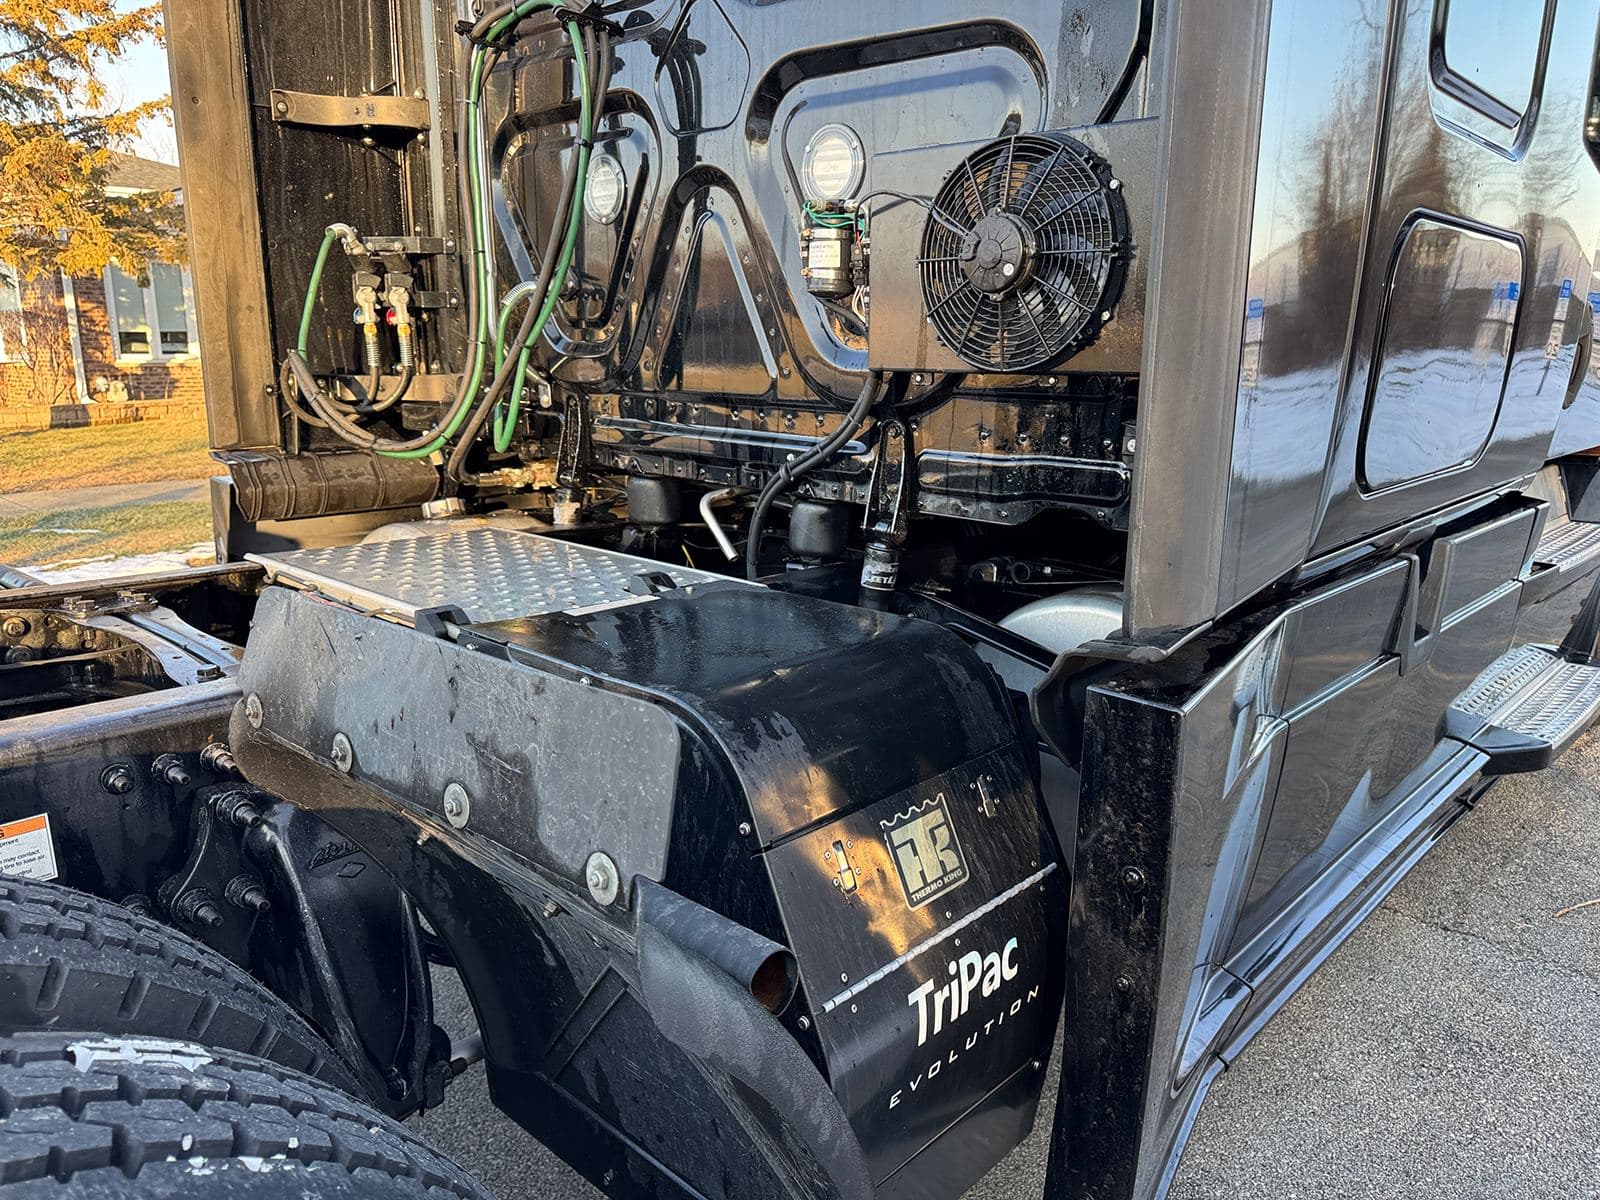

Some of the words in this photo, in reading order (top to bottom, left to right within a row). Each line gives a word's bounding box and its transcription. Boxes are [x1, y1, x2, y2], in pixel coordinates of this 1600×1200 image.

[911, 880, 943, 902] THERMO
[943, 869, 963, 885] KING
[889, 985, 1039, 1109] EVOLUTION
[908, 937, 1019, 1047] TriPac
